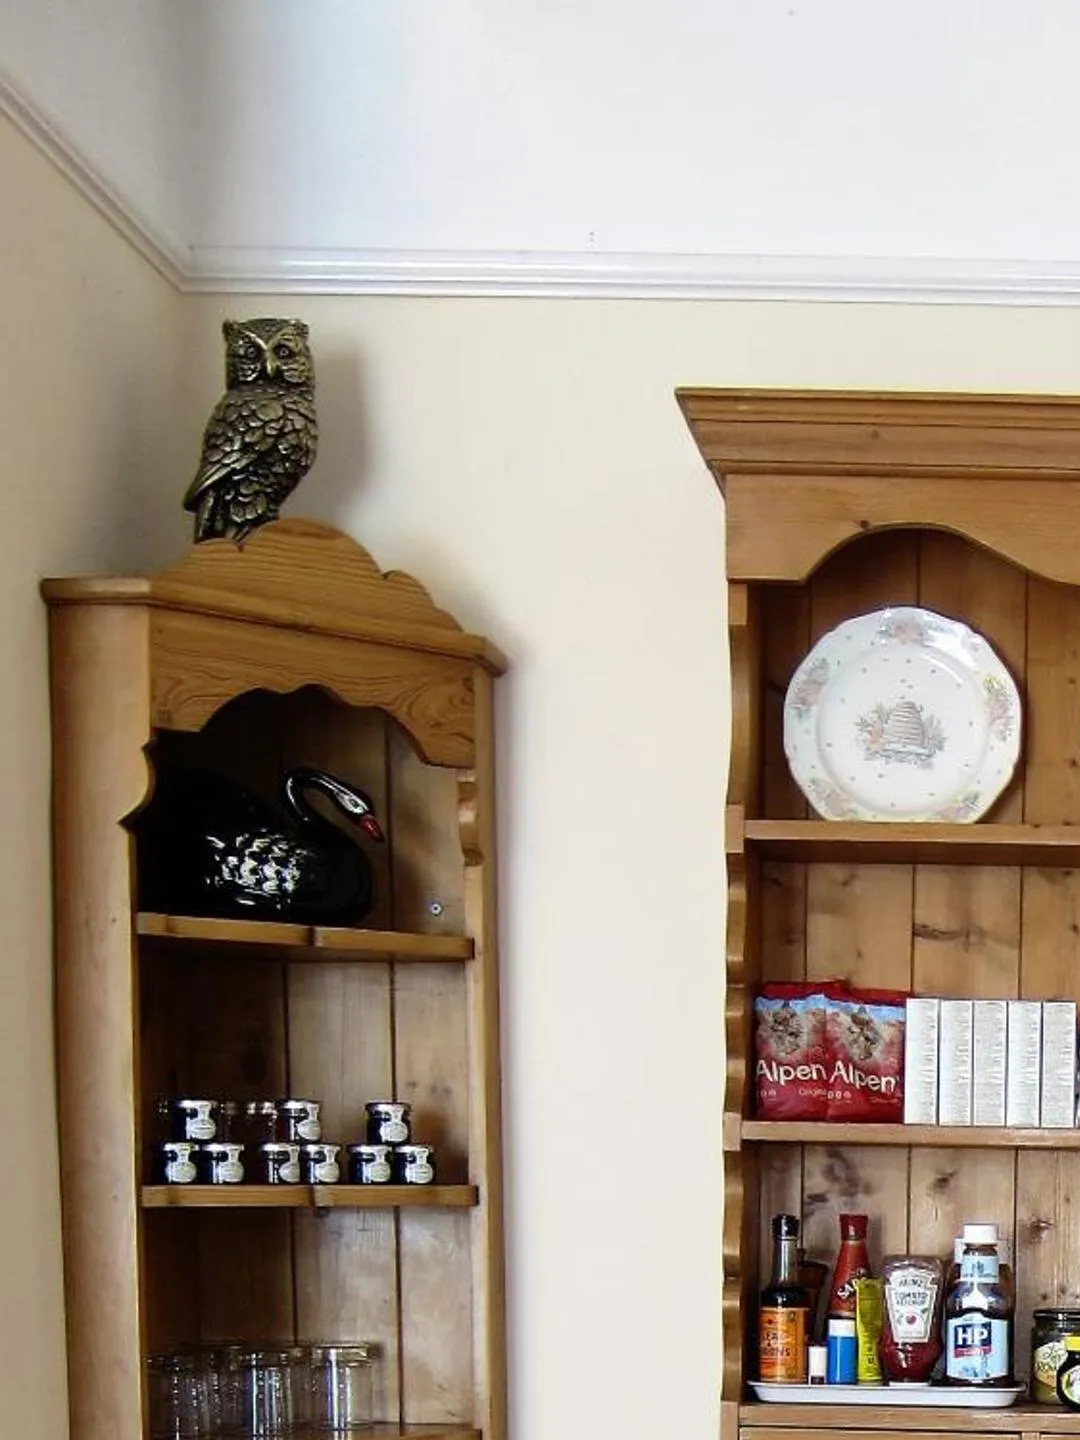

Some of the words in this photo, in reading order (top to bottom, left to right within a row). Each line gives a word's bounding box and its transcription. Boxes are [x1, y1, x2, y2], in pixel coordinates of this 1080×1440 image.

[755, 1059, 827, 1086] Alpen
[829, 1060, 897, 1093] Alpen
[956, 1326, 988, 1346] HP
